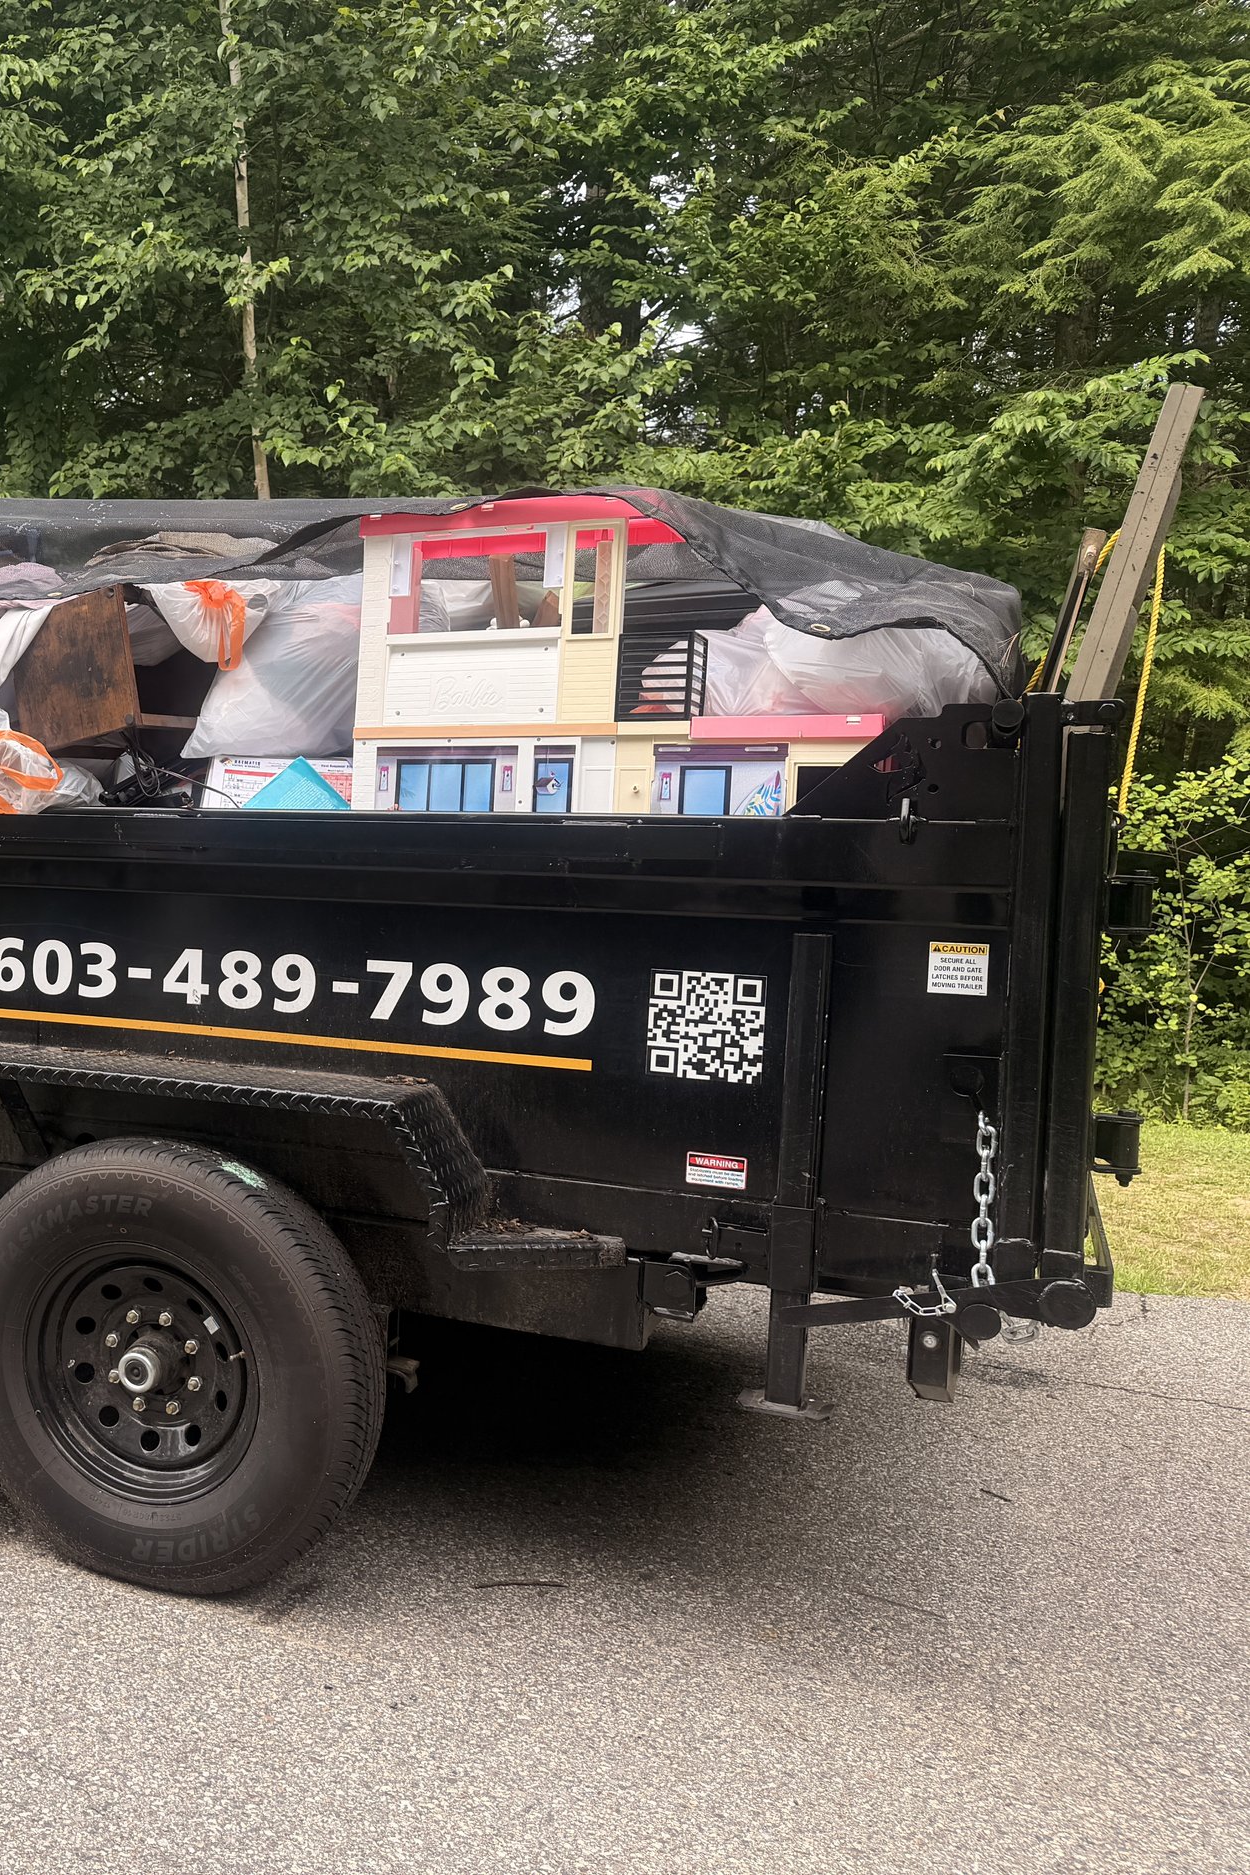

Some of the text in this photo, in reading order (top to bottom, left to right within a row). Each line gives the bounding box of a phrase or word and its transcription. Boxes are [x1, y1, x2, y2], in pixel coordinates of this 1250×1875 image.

[433, 675, 504, 712] Barbie
[942, 945, 985, 953] CAUTION
[695, 1157, 738, 1168] WARNING
[130, 1503, 263, 1563] STRIDER
